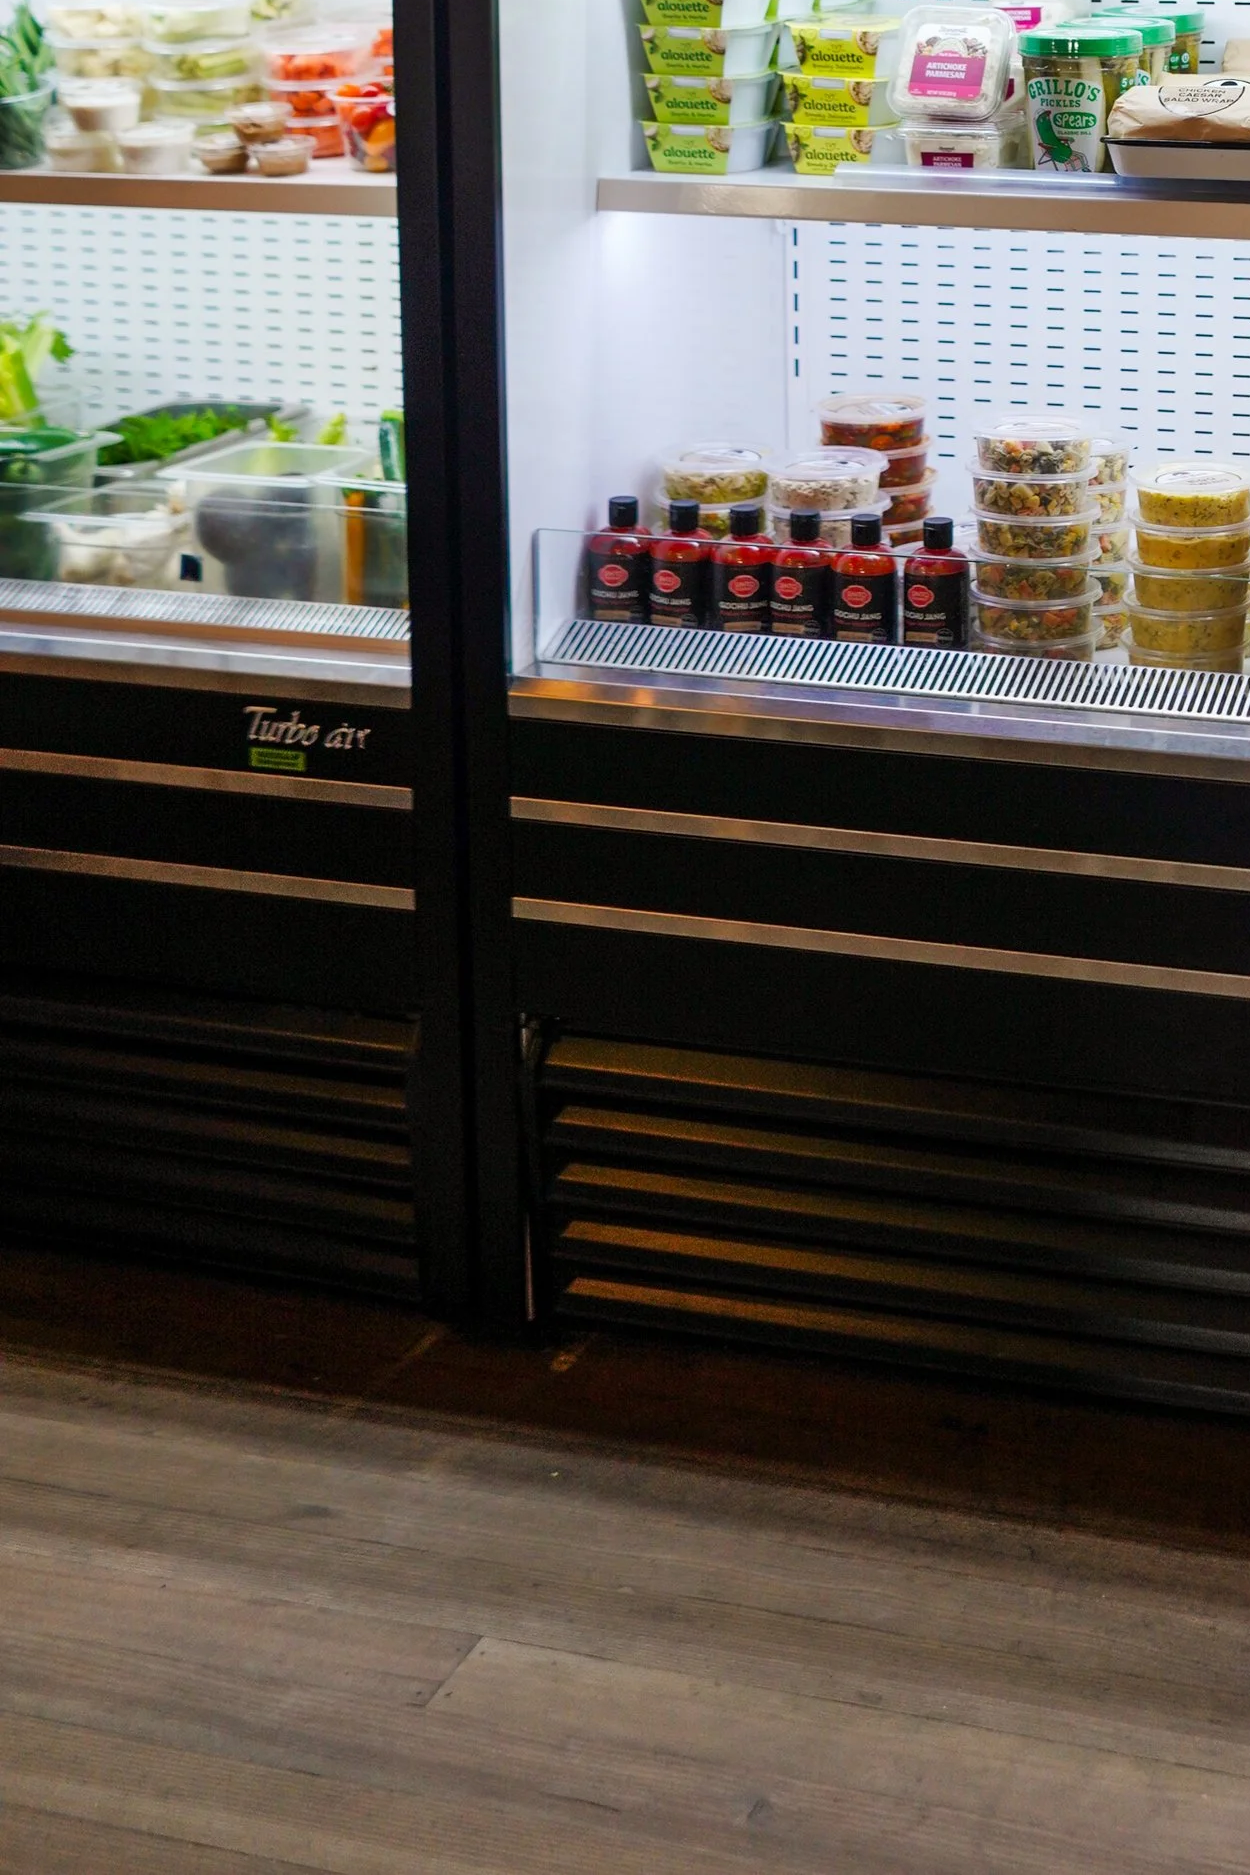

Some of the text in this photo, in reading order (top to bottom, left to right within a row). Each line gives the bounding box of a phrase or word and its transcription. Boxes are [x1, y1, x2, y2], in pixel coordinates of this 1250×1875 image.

[657, 0, 709, 12] alouette
[661, 49, 712, 62] alouette
[810, 50, 863, 63] alouette
[926, 62, 967, 71] ARTICHOKE
[925, 70, 965, 79] PARMESAN
[665, 97, 717, 110] alouette
[803, 100, 856, 113] alouette
[1040, 98, 1081, 108] PICKLES
[663, 146, 716, 159] alouette
[805, 149, 858, 162] alouette
[243, 705, 371, 750] Turbo air
